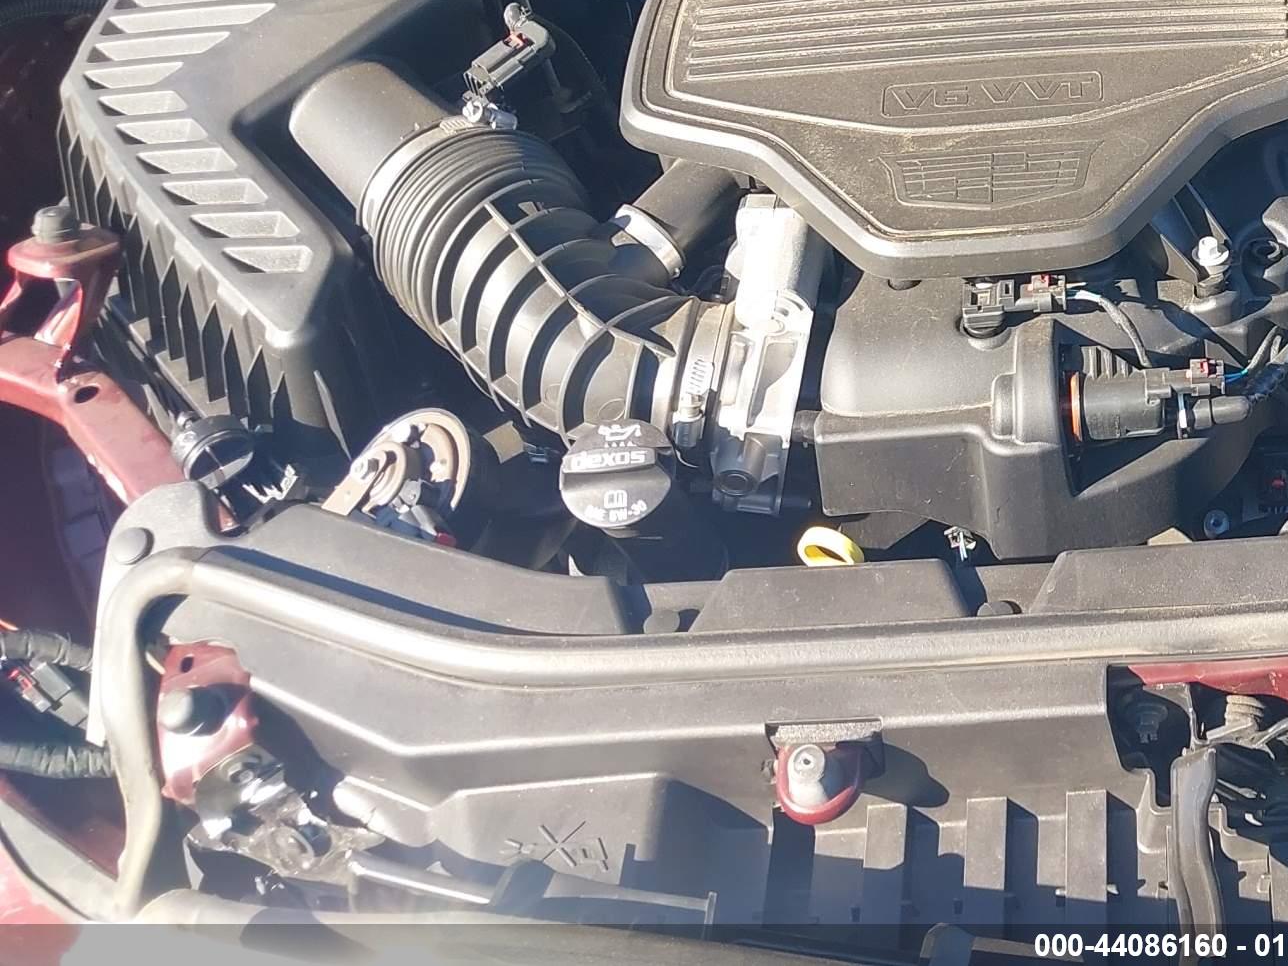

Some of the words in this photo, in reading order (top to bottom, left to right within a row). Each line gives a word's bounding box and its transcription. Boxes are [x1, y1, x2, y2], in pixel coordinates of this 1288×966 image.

[890, 83, 969, 110] V6
[979, 77, 1094, 103] VVT
[570, 450, 648, 470] dexos
